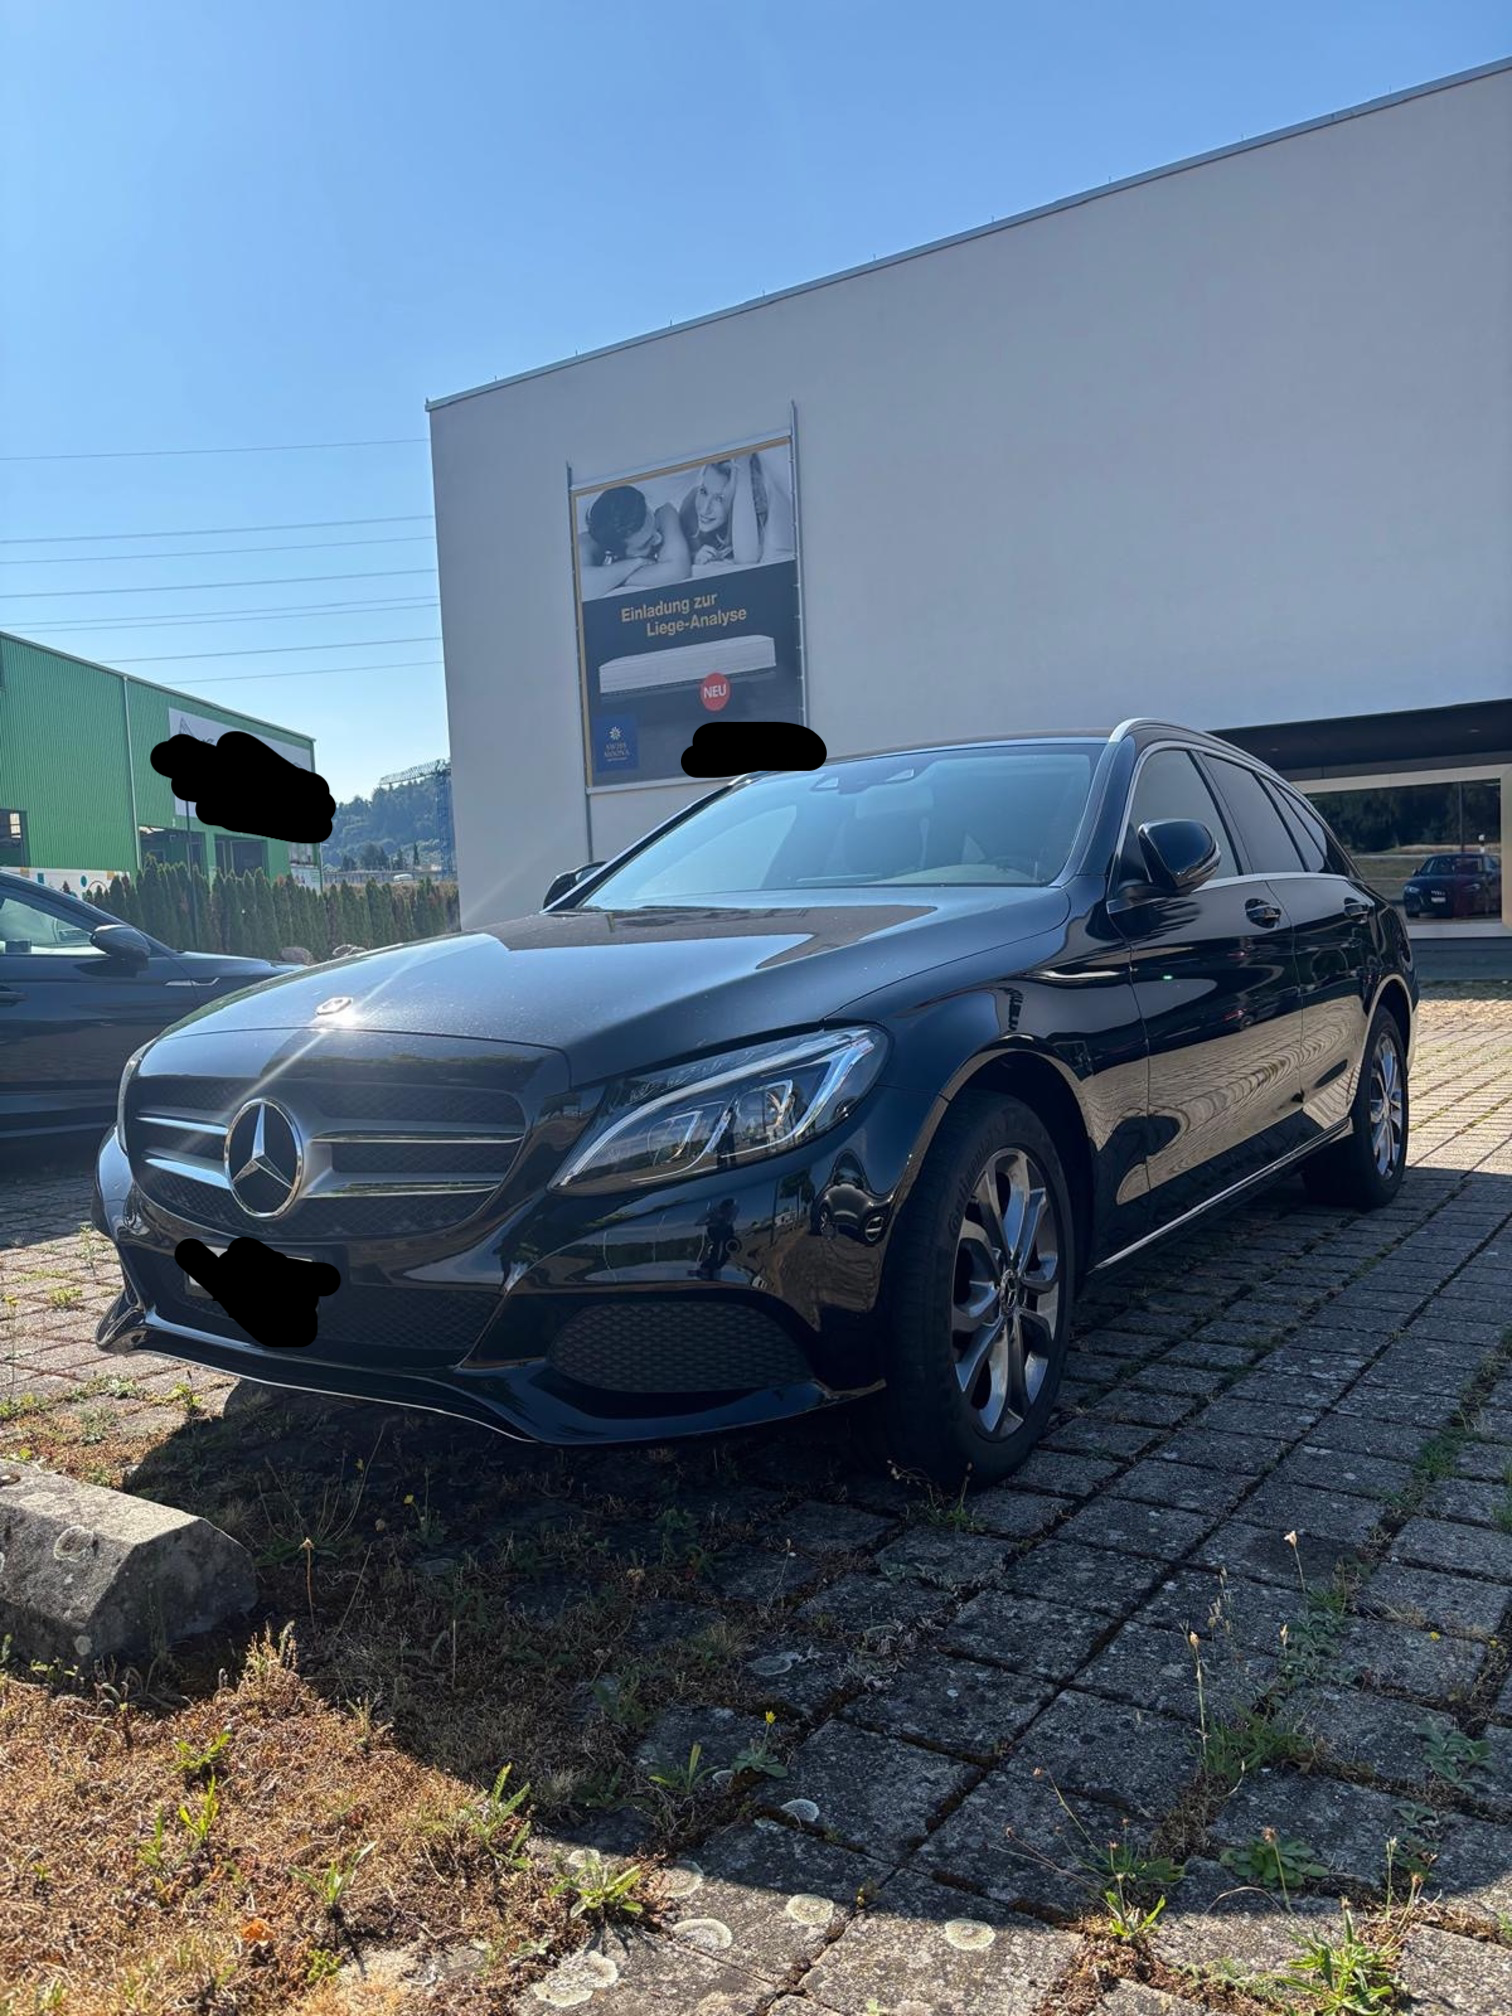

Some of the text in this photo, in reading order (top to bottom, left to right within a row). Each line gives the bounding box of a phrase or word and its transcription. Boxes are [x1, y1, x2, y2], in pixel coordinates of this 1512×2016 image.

[621, 593, 718, 622] Einladung zur
[646, 608, 747, 636] Liege-Analyse
[703, 683, 727, 698] NEU
